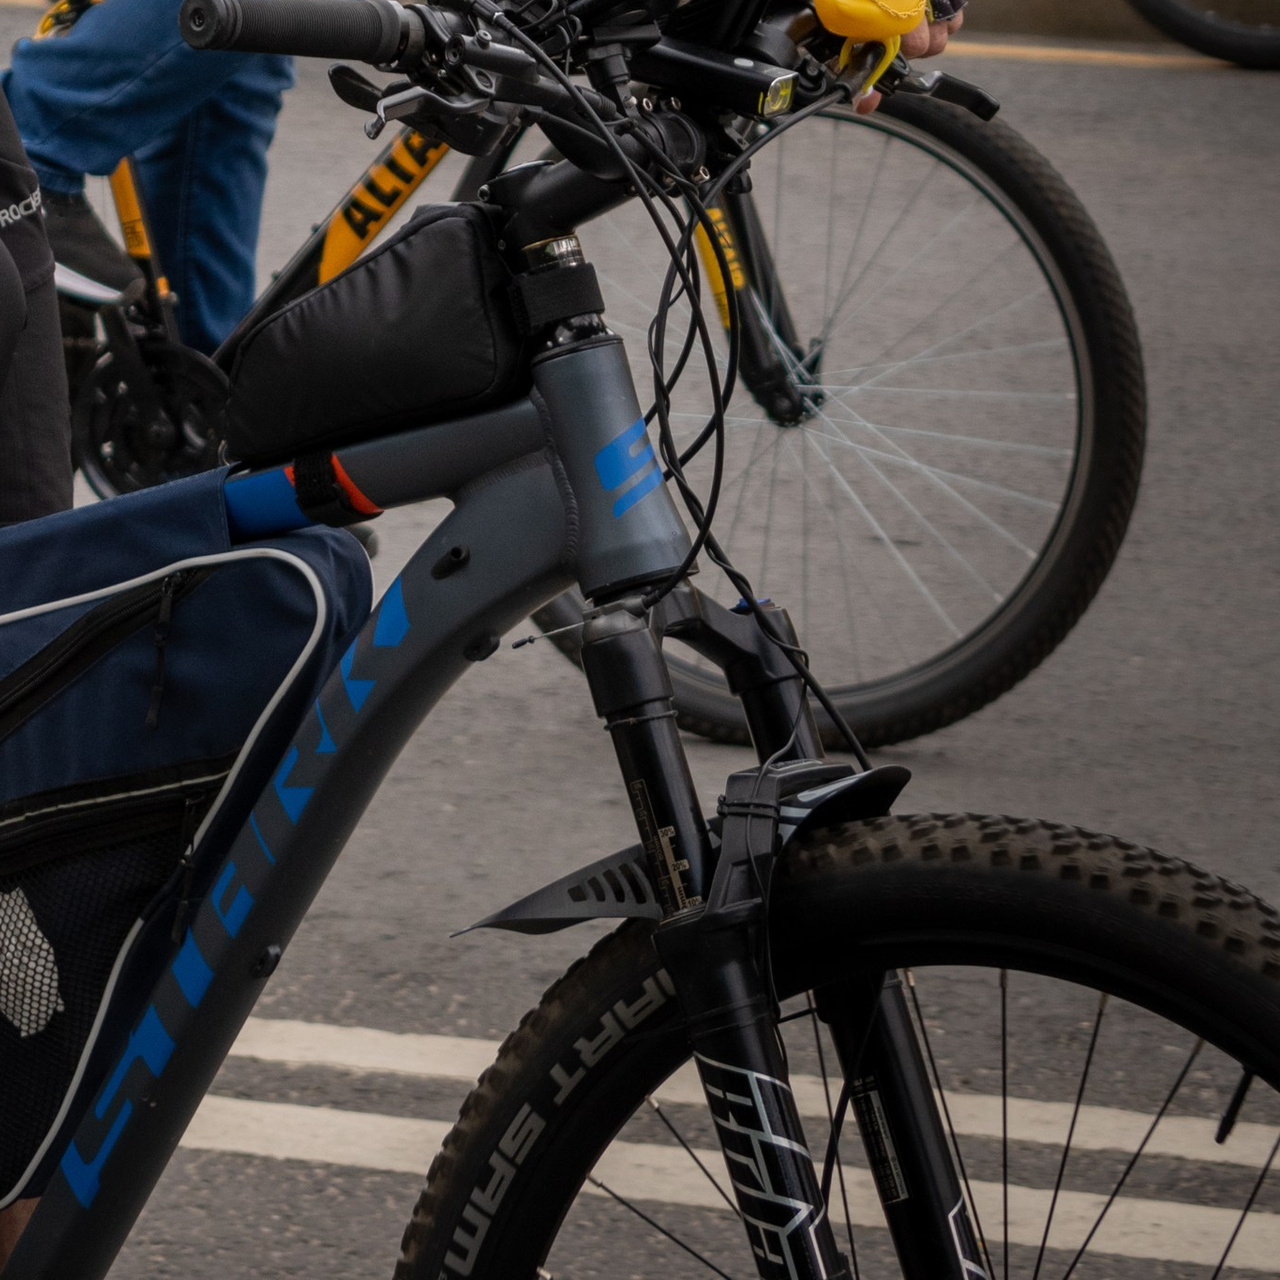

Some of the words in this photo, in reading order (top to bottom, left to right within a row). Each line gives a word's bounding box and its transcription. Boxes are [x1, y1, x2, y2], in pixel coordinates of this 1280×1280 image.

[342, 130, 444, 239] ALTA
[549, 968, 677, 1106] ART
[443, 1101, 548, 1277] SAM
